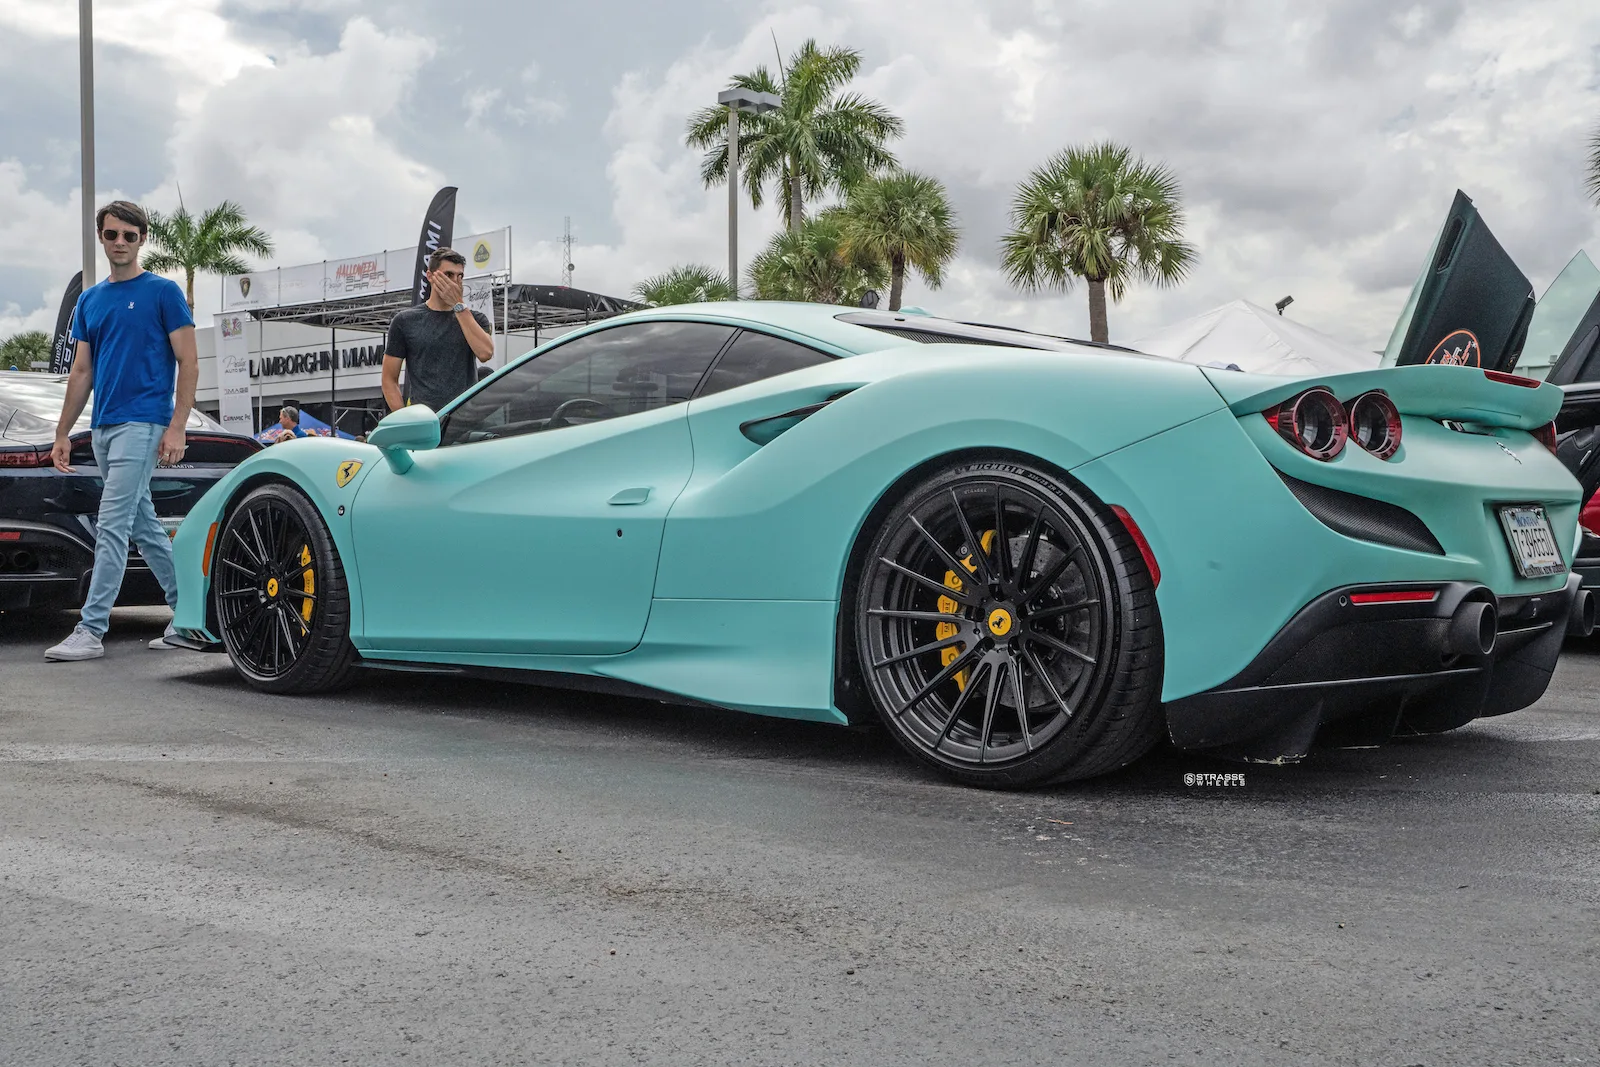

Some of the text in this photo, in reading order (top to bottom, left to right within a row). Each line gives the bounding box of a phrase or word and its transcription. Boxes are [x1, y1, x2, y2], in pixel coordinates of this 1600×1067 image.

[336, 260, 377, 278] HALLOWEEN
[346, 270, 385, 284] SUPER
[346, 282, 369, 292] CAR
[54, 334, 65, 366] Pagani
[969, 463, 1025, 475] MICHELIN
